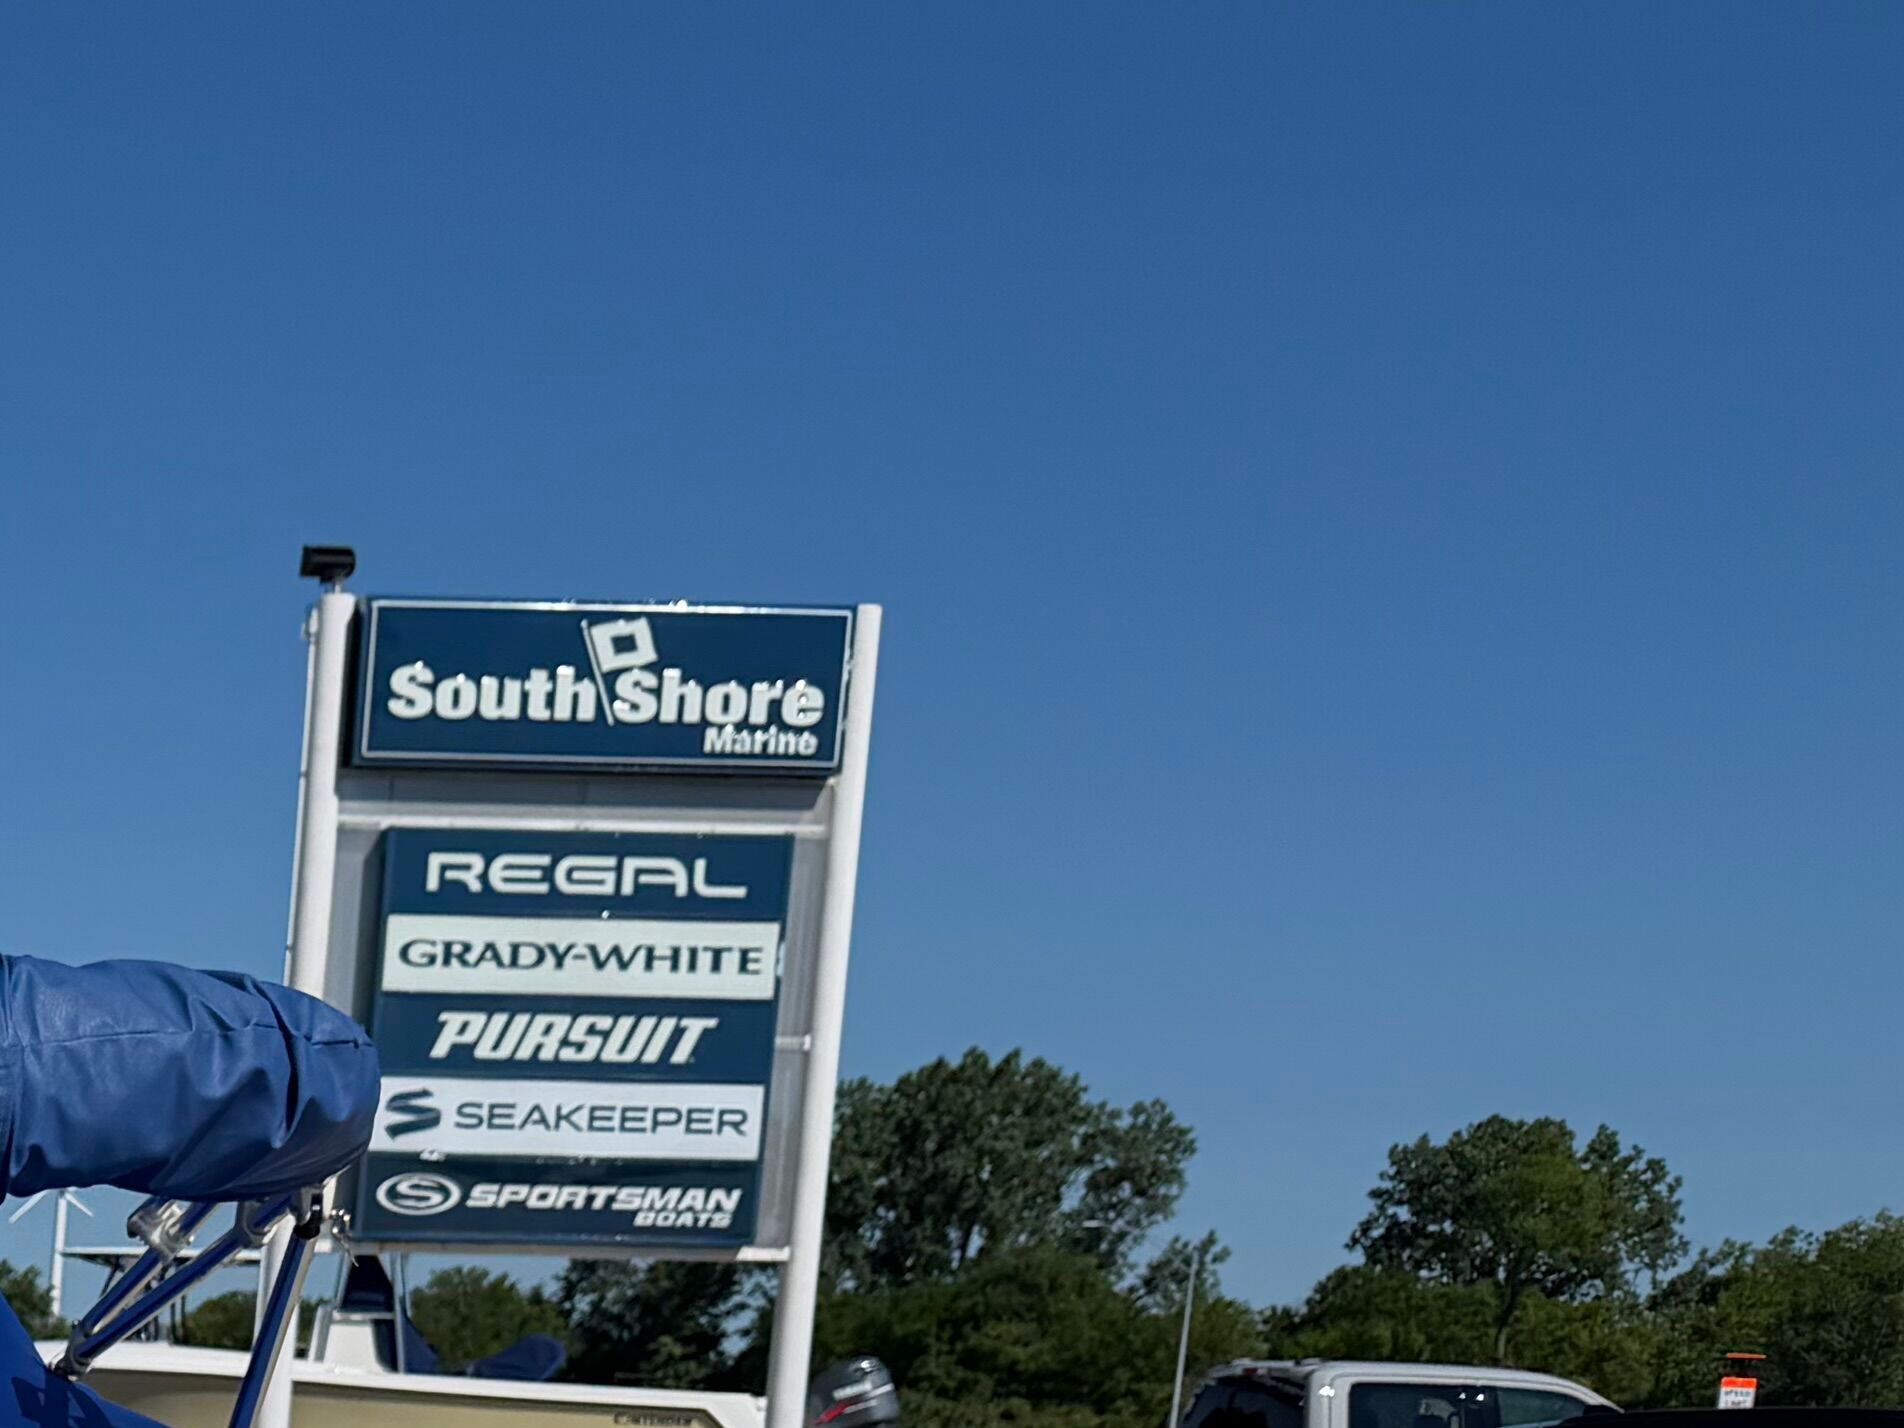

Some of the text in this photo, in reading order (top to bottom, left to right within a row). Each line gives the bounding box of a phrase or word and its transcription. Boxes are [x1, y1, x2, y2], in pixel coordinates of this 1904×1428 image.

[388, 661, 824, 727] South Shore
[703, 723, 818, 757] Marine
[425, 851, 748, 899] REGAL
[398, 938, 764, 976] GRADY-WHITE
[429, 1010, 719, 1065] PURSUIT
[453, 1101, 748, 1137] SEAKEEPER
[465, 1183, 742, 1213] SPORTSMAN
[634, 1210, 733, 1229] BOATS
